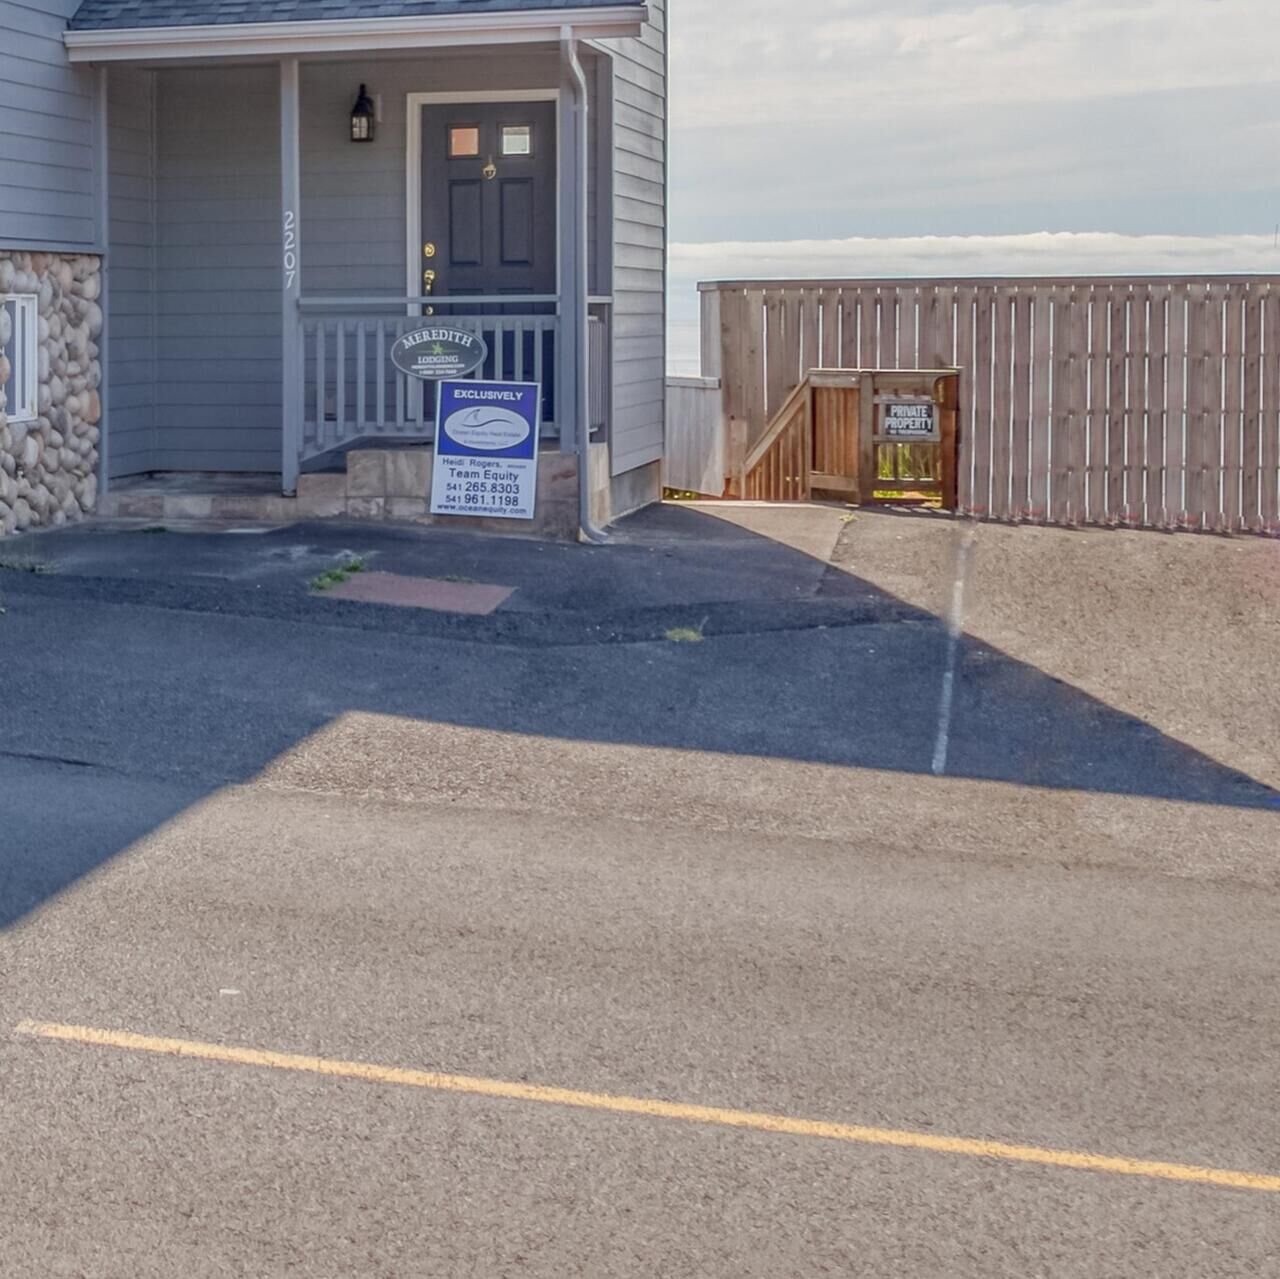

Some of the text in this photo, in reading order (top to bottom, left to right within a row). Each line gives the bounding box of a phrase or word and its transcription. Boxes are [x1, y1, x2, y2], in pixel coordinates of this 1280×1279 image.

[284, 211, 295, 289] 2207
[402, 329, 473, 349] MEREDITH
[418, 355, 459, 364] LODGING
[454, 389, 523, 400] EXCLUSIVELY
[891, 405, 928, 417] PRIVATE
[885, 417, 933, 429] PROPERTY
[449, 468, 519, 483] Team Equity
[446, 481, 520, 494] 541 265.8303
[445, 494, 519, 506] 541 961.1198
